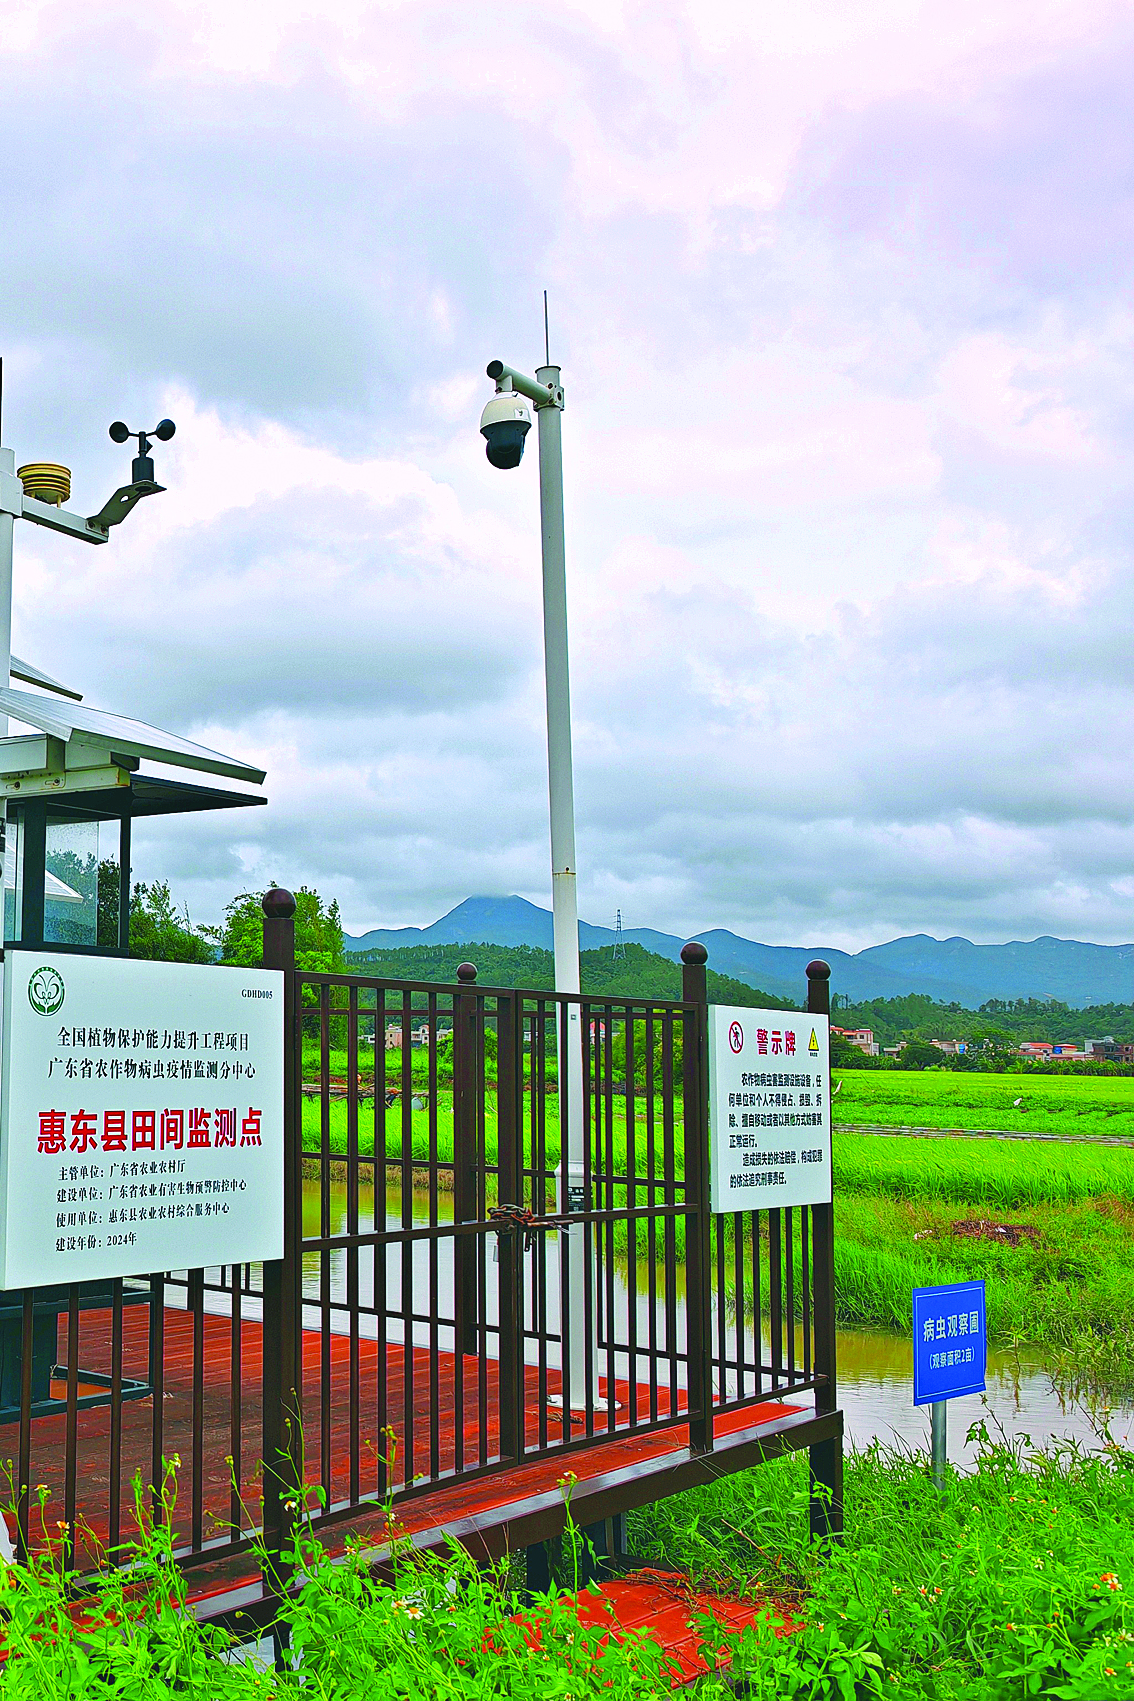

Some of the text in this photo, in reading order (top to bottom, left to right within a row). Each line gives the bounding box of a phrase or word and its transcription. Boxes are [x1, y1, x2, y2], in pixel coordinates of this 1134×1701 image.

[241, 989, 273, 999] GDHD005
[57, 1026, 250, 1051] 全国植物保护能力提升工程项目
[756, 1028, 796, 1056] 警示牌
[47, 1057, 256, 1080] 广东省农作物病虫疫情监测分中心
[37, 1107, 263, 1154] 惠东县田间监测点
[58, 1159, 186, 1181] 主管单位：广东省农业农村厅
[56, 1202, 230, 1227] 使用单位：惠东县农业农村综合服务中心
[55, 1231, 137, 1252] 建设年份：2024年
